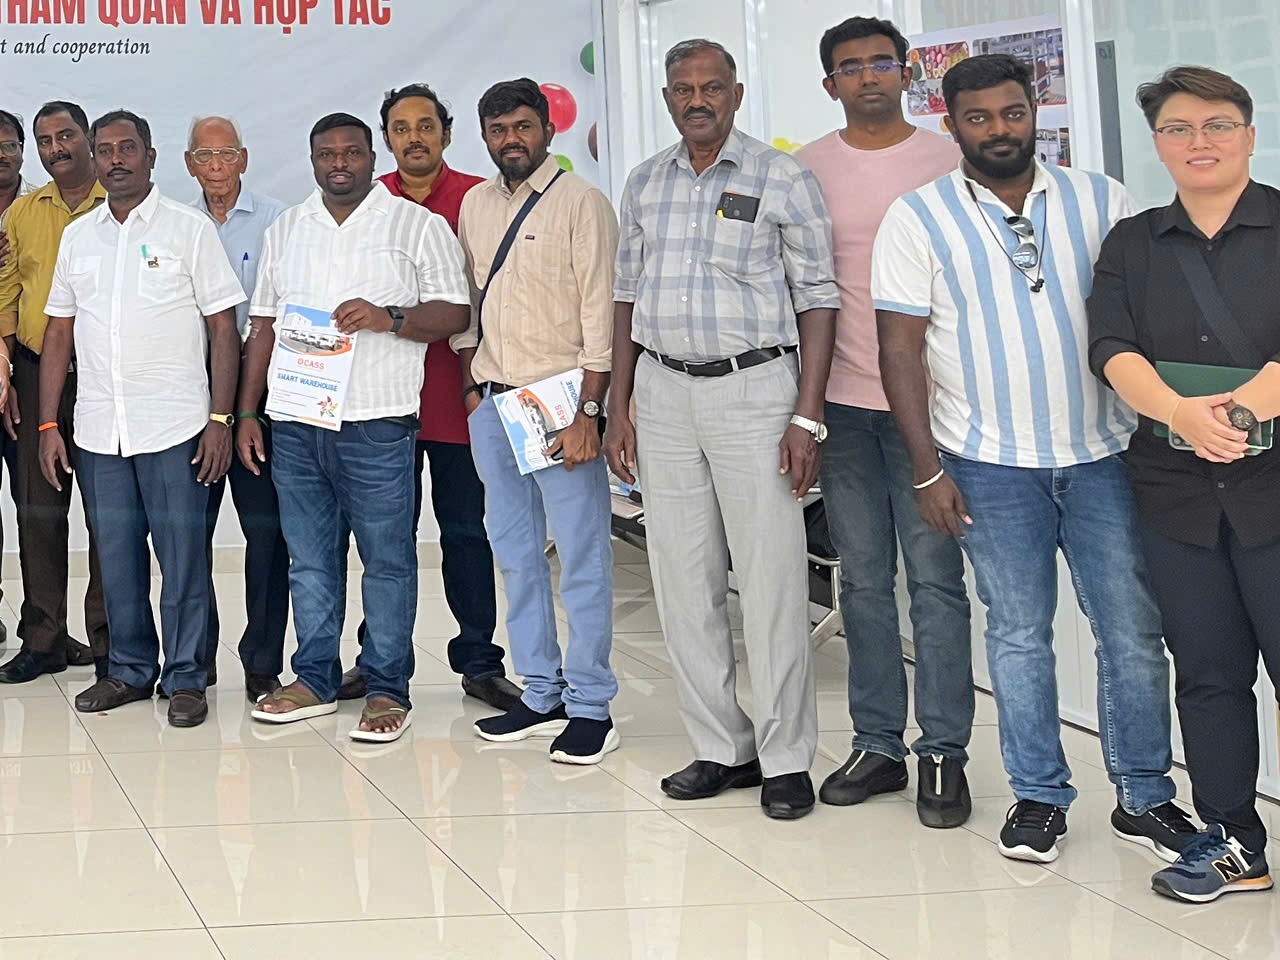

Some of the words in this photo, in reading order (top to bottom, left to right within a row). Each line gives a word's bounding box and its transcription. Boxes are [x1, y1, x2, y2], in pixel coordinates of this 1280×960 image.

[13, 32, 50, 55] and
[52, 37, 151, 63] cooperation
[277, 373, 298, 382] SMART
[300, 377, 338, 392] WAREHOUSE
[1211, 853, 1244, 883] N
